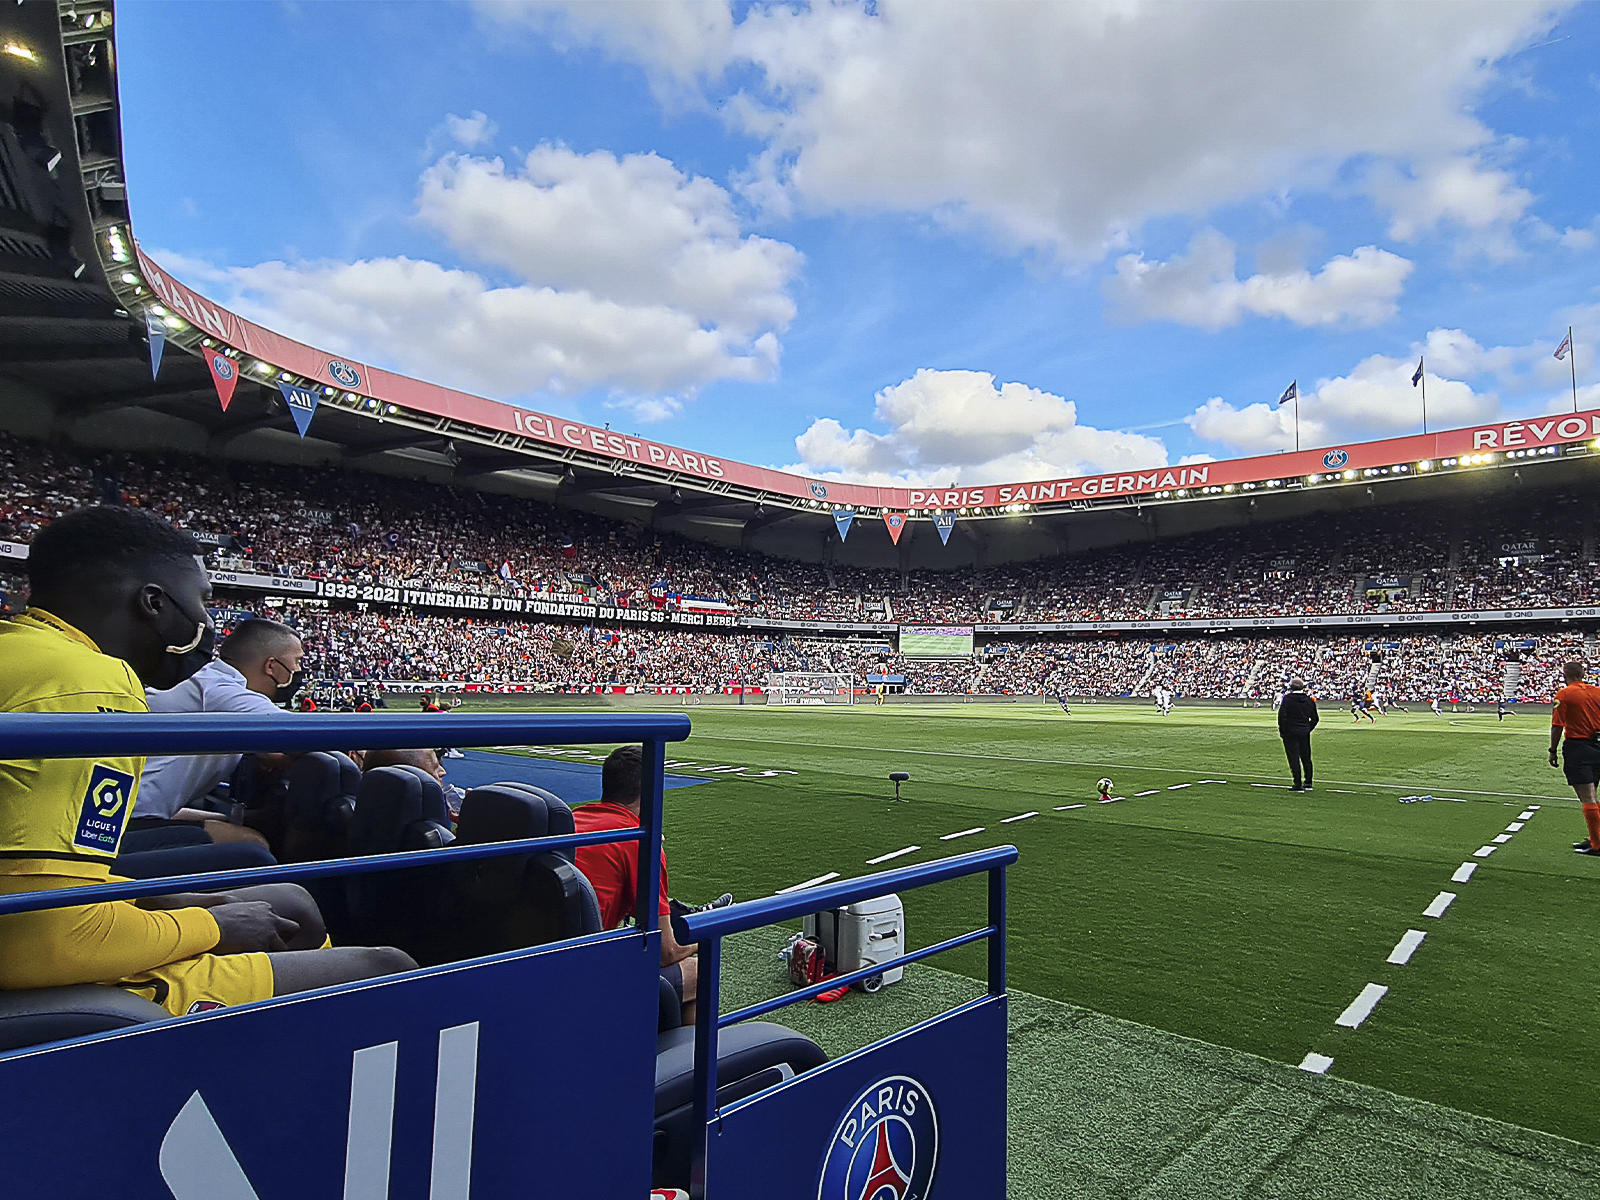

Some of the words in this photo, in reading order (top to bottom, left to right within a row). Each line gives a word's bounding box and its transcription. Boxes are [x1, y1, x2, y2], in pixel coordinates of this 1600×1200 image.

[1473, 415, 1600, 450] RÊVO
[513, 411, 555, 439] ICI
[562, 424, 643, 459] C'EST
[647, 444, 725, 478] PARIS
[909, 489, 985, 506] PARIS
[999, 466, 1209, 503] SAINT-GERMAIN
[298, 508, 332, 520] QATAR
[192, 531, 219, 540] QATAR
[1501, 541, 1535, 551] QATAR
[1270, 559, 1296, 567] QATAR
[214, 573, 237, 582] QNB
[282, 580, 303, 588] QNB
[317, 581, 400, 603] 1933-2021
[403, 589, 489, 610] ITINÉRAIRE
[492, 597, 522, 612] D'UN
[525, 600, 597, 618] FONDATEUR
[599, 606, 615, 619] DU
[615, 609, 650, 622] PARIS
[650, 611, 665, 623] SG
[671, 613, 704, 626] MERCI
[705, 615, 739, 627] BEBEL
[1460, 612, 1480, 620] QNB
[1575, 608, 1596, 616] QNB
[1406, 614, 1424, 622] QNB
[86, 819, 111, 831] LIGUE
[112, 825, 116, 833] 1
[81, 829, 98, 840] Uber
[98, 833, 115, 844] Eats
[840, 1085, 919, 1148] PARIS
